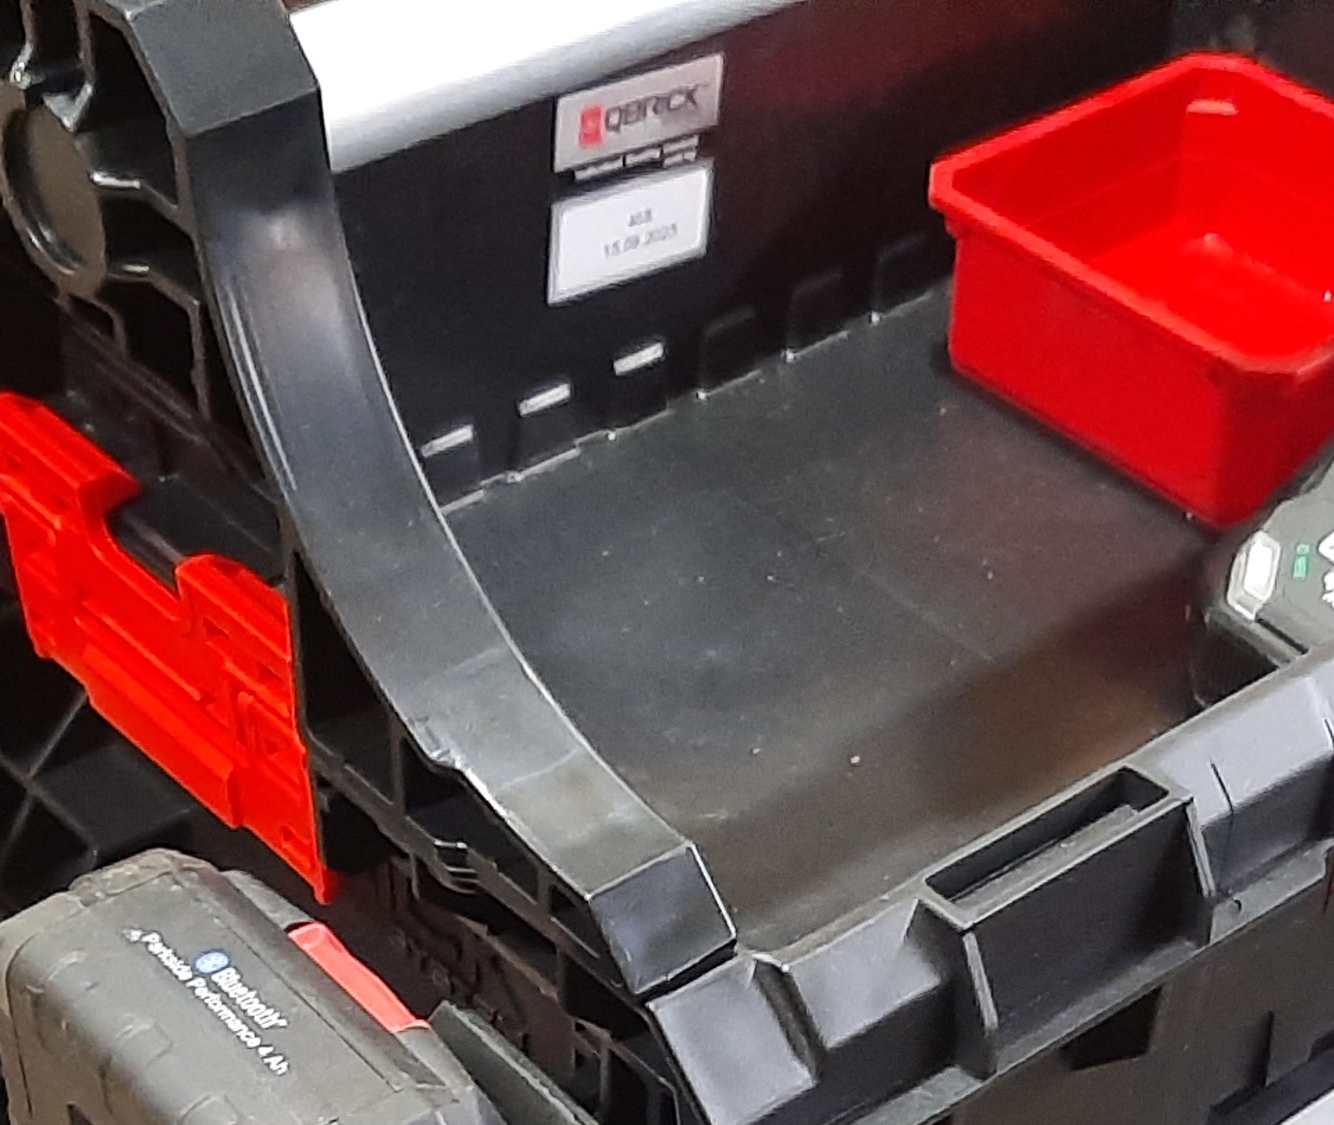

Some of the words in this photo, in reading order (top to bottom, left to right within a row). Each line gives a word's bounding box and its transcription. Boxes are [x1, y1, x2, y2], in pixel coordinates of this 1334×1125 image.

[140, 931, 194, 981] Parkside
[186, 976, 261, 1048] Performance
[211, 966, 287, 1030] Bluetooth
[258, 1045, 274, 1058] 4
[263, 1055, 290, 1076] Ah
